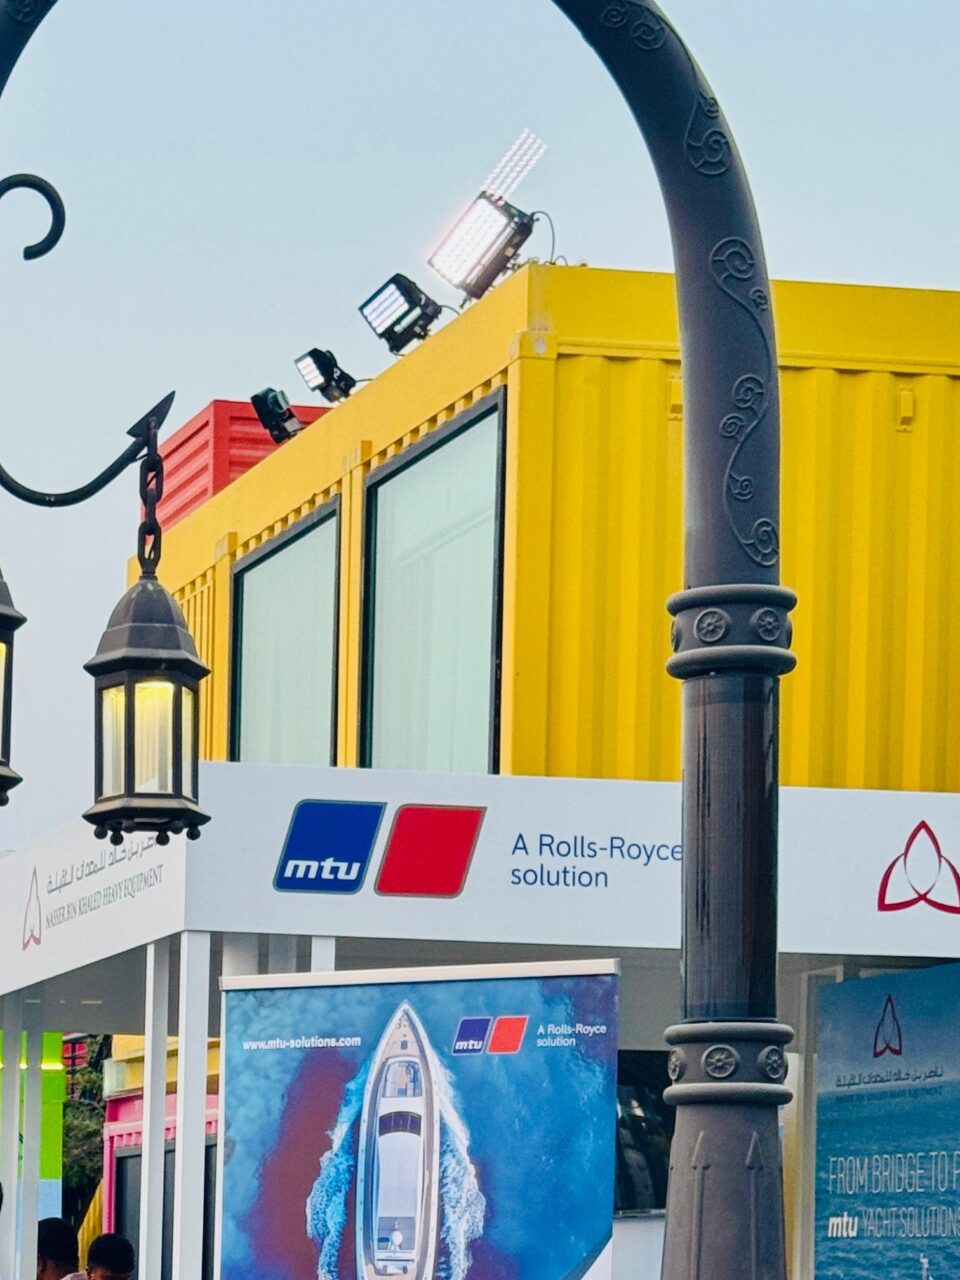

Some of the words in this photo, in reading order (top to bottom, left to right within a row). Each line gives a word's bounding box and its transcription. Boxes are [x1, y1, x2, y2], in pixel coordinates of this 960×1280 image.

[512, 834, 529, 856] A
[539, 834, 682, 867] Rolls-Royce
[124, 864, 163, 898] EQUIPMENT
[284, 856, 361, 881] mtu
[511, 863, 609, 888] solution
[537, 1024, 545, 1035] A
[548, 1023, 607, 1036] Rolls-Royce
[537, 1036, 576, 1048] solution
[243, 1036, 362, 1050] www.mtu-solutions.com
[455, 1039, 483, 1051] mtu
[829, 1156, 868, 1195] FROM
[872, 1152, 925, 1194] BRIDGE
[929, 1150, 948, 1192] TO
[828, 1211, 858, 1238] mtu
[862, 1207, 897, 1238] YACHT
